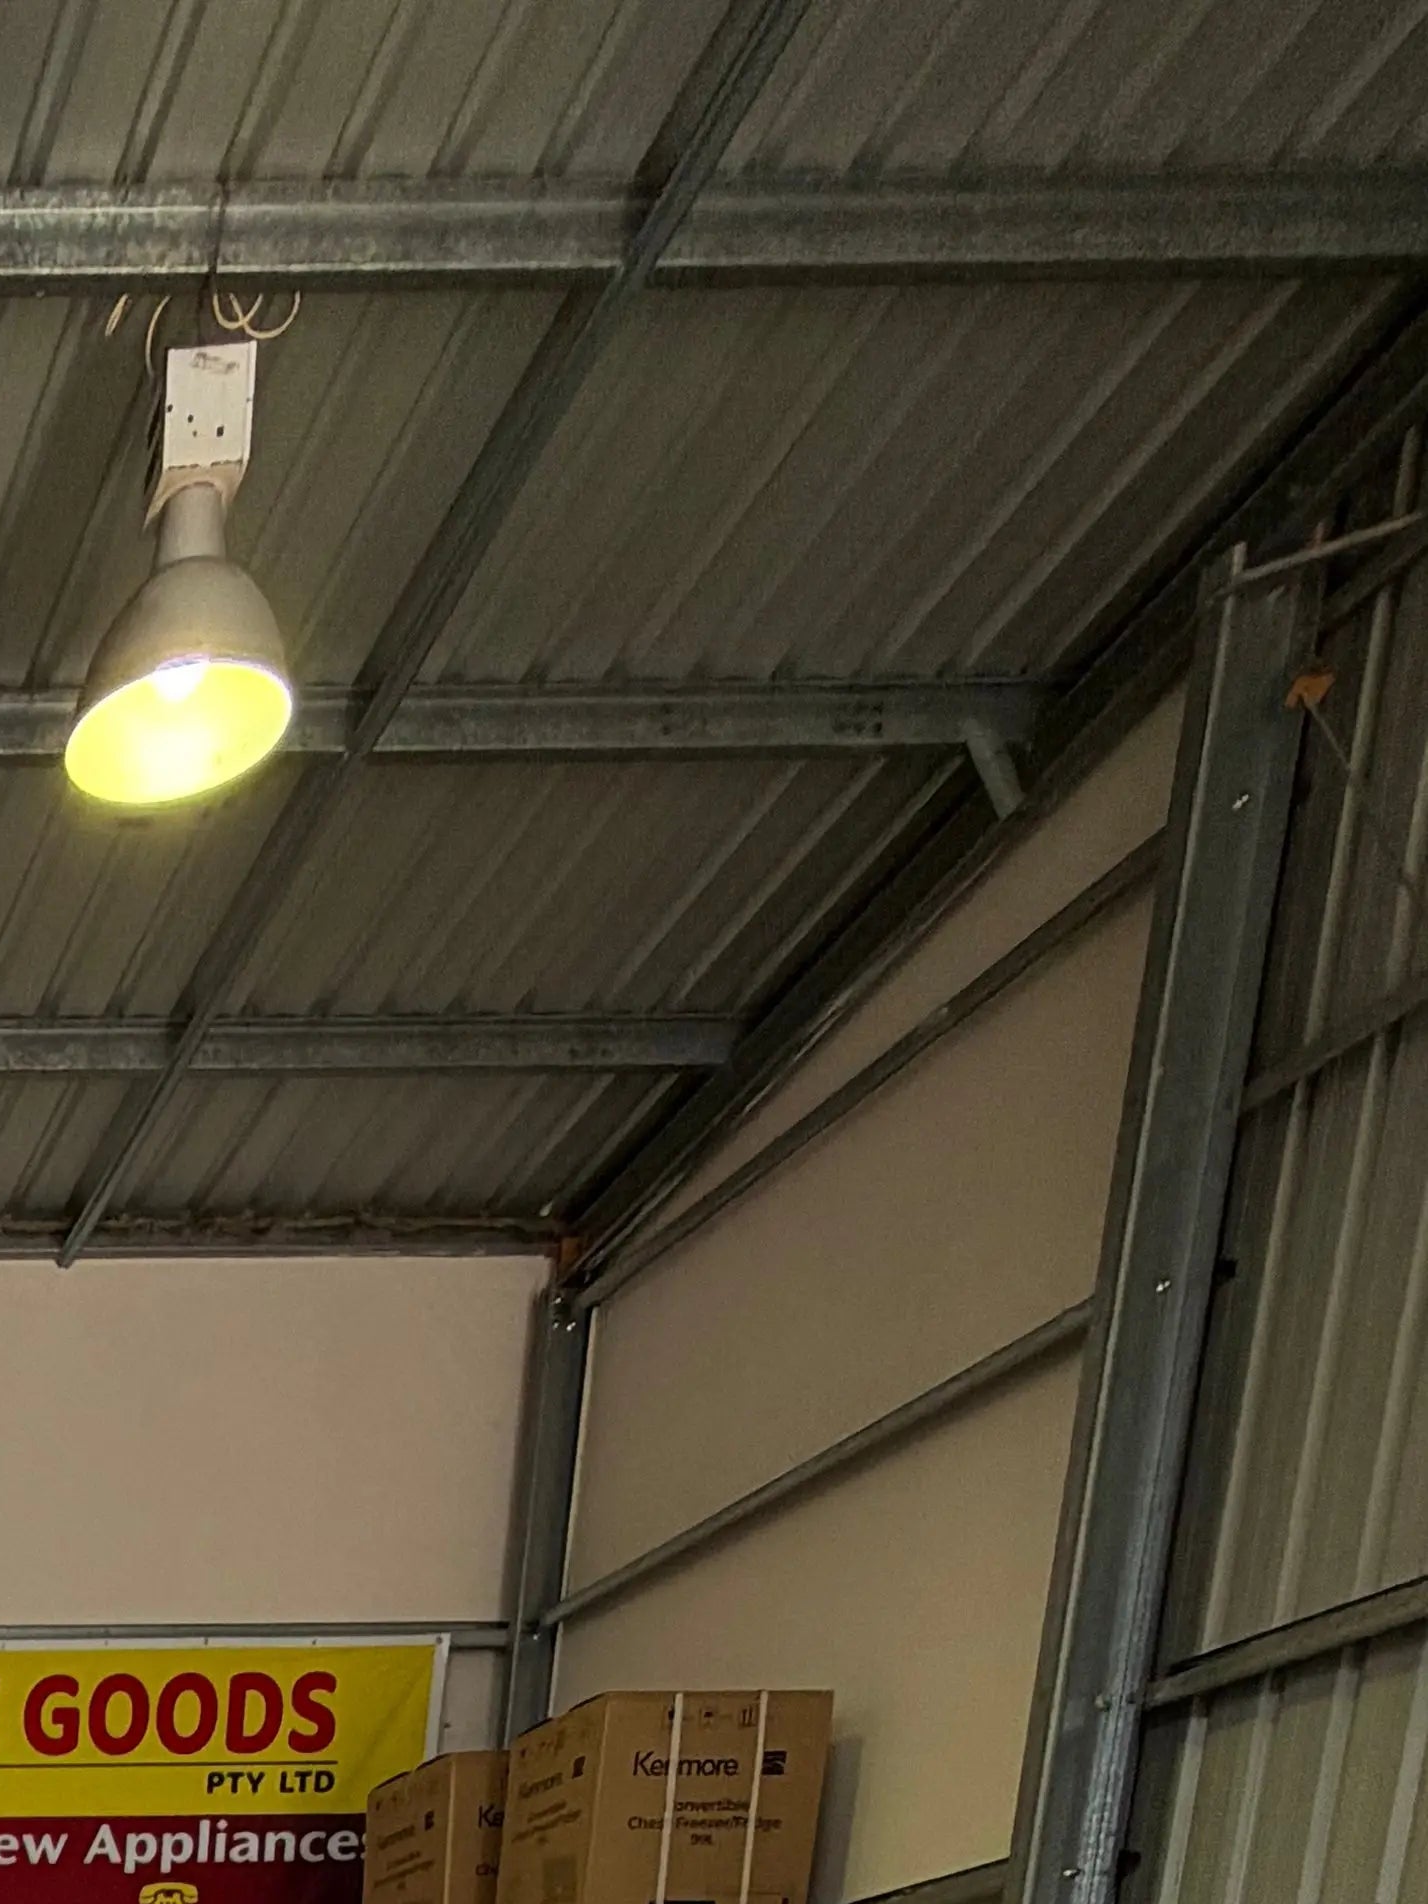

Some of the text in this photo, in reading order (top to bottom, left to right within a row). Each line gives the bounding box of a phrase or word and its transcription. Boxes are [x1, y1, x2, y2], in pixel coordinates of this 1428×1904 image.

[23, 1671, 338, 1756] GOODS
[206, 1770, 336, 1795] PTY LTD
